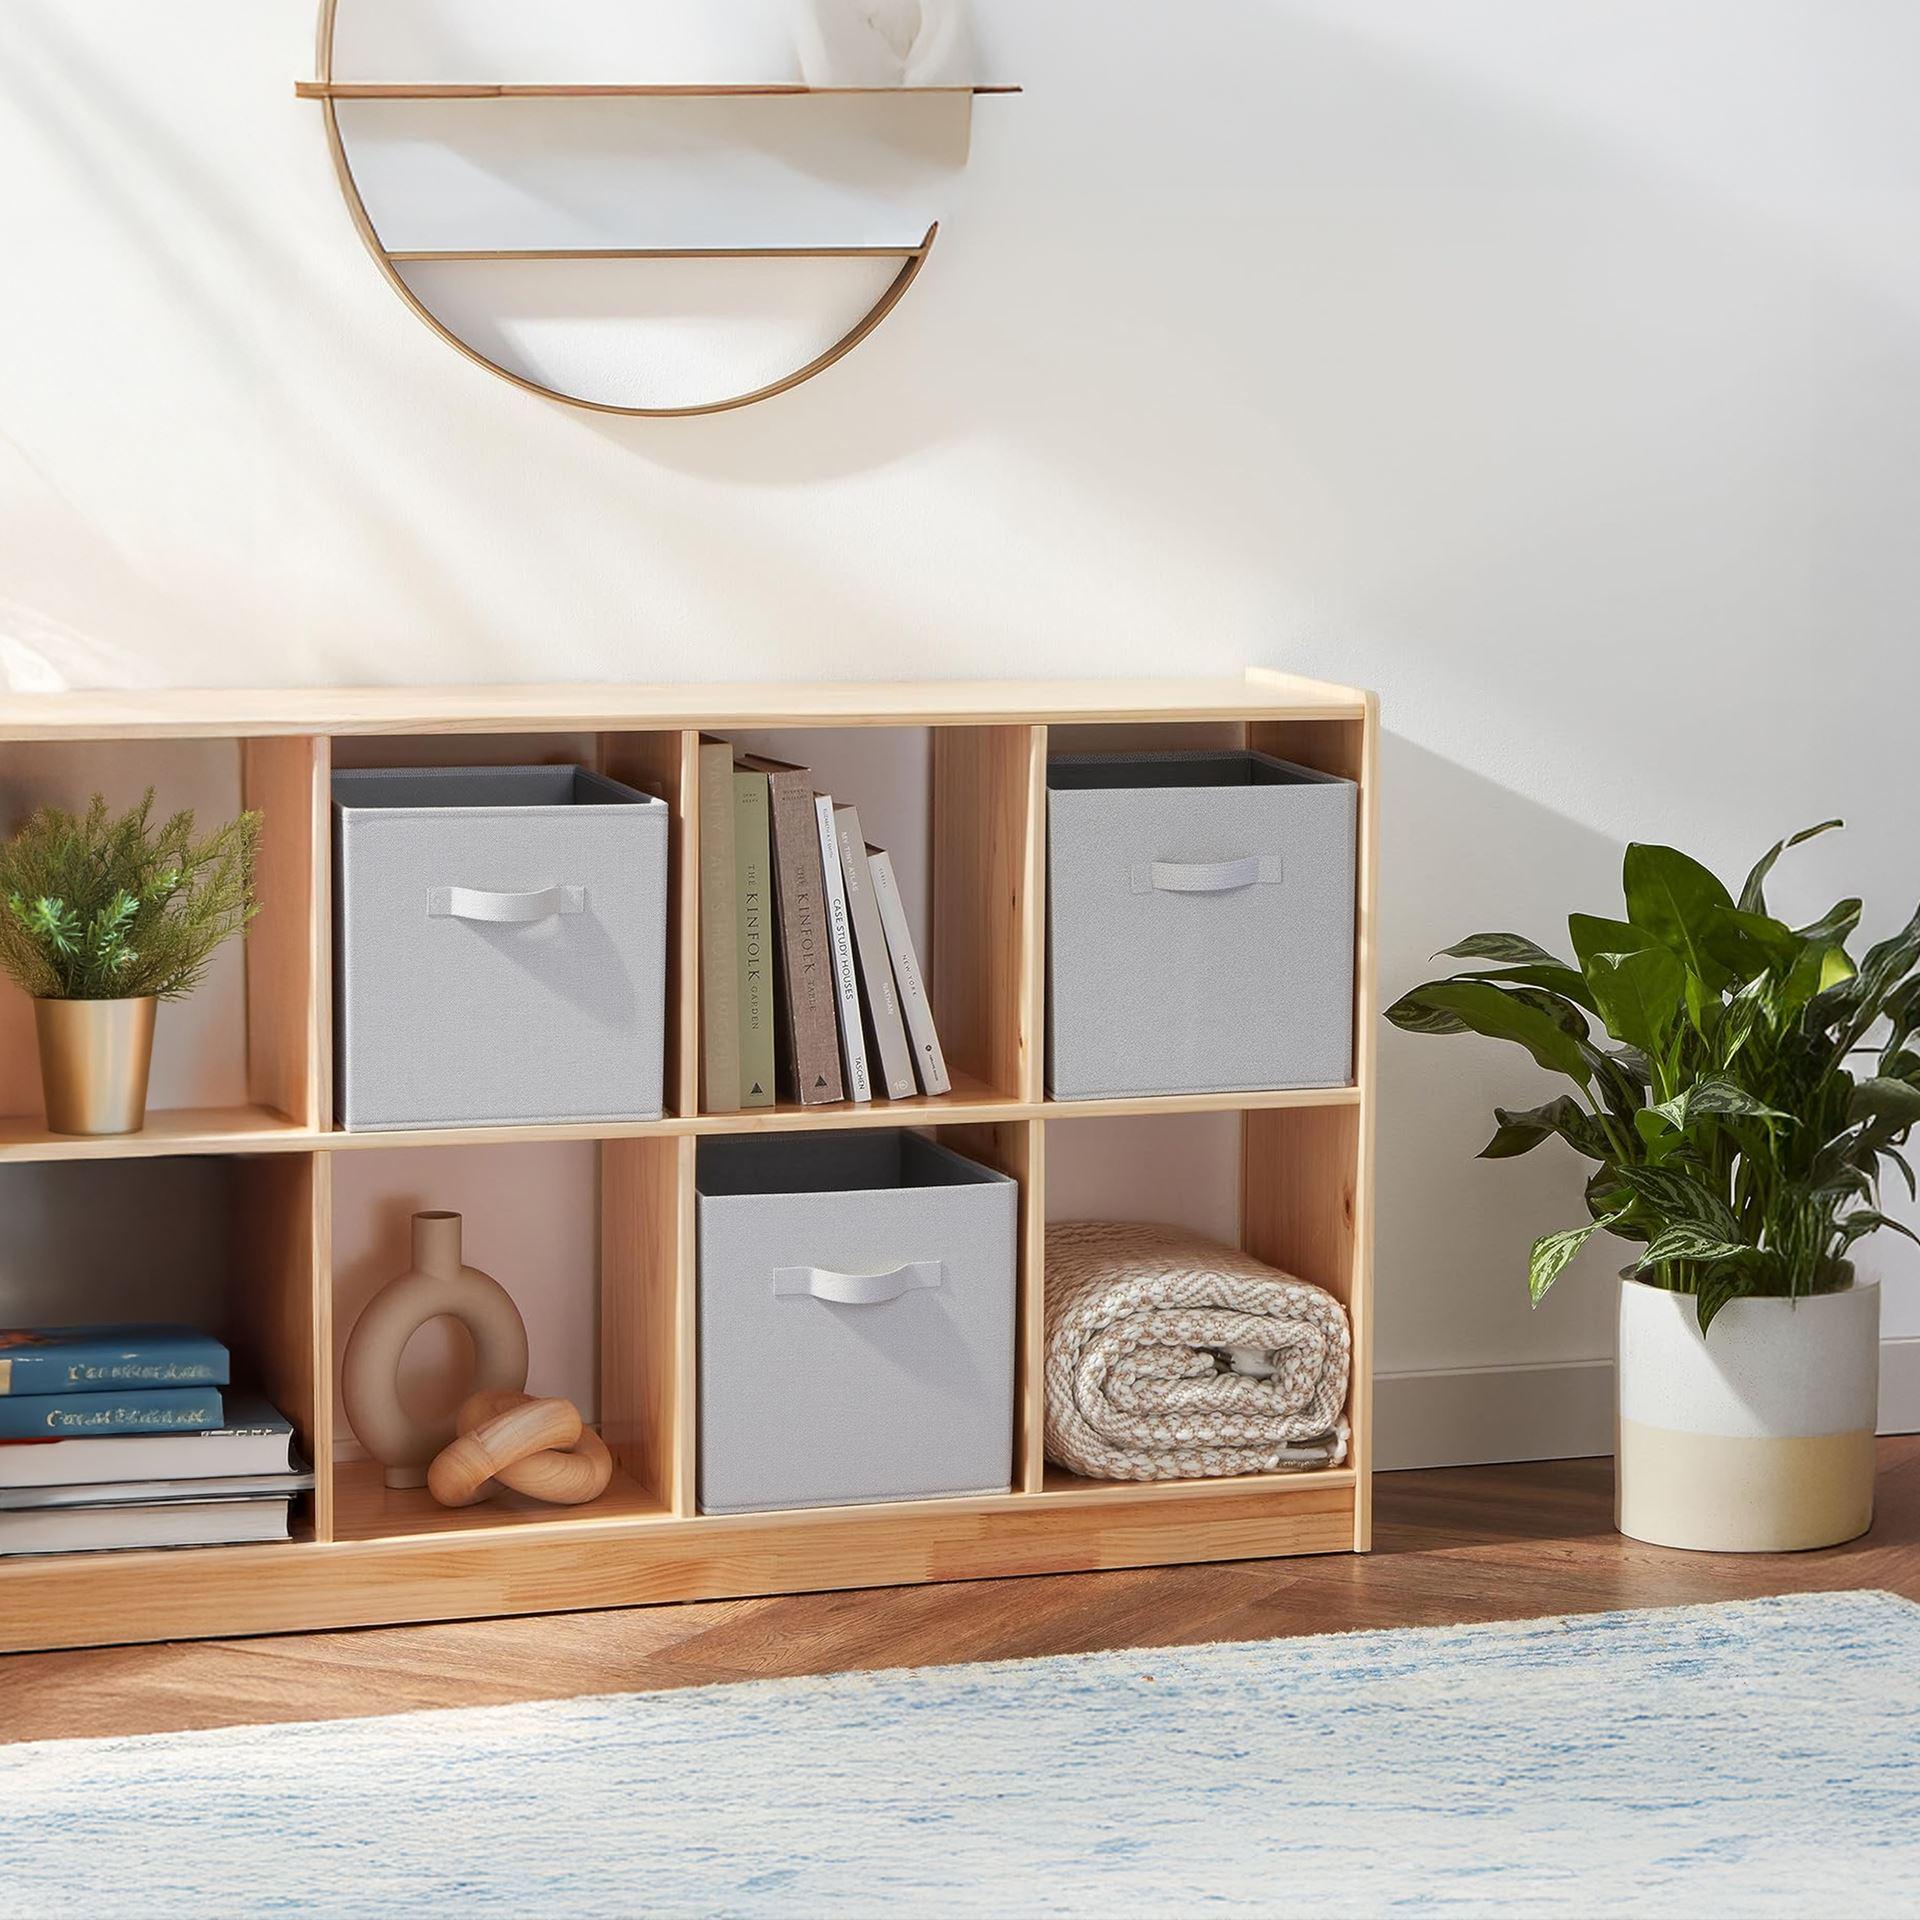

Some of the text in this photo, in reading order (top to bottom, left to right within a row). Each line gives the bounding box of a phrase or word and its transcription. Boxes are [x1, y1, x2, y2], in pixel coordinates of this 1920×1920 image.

[746, 864, 760, 1030] THE KINFOLK GARDEN
[797, 893, 816, 974] KINFOLK
[807, 979, 817, 1012] TABLE
[833, 898, 853, 1000] CASE STUDY HOUSES
[903, 954, 917, 997] NEW YORK
[855, 1056, 865, 1090] TASCHEN
